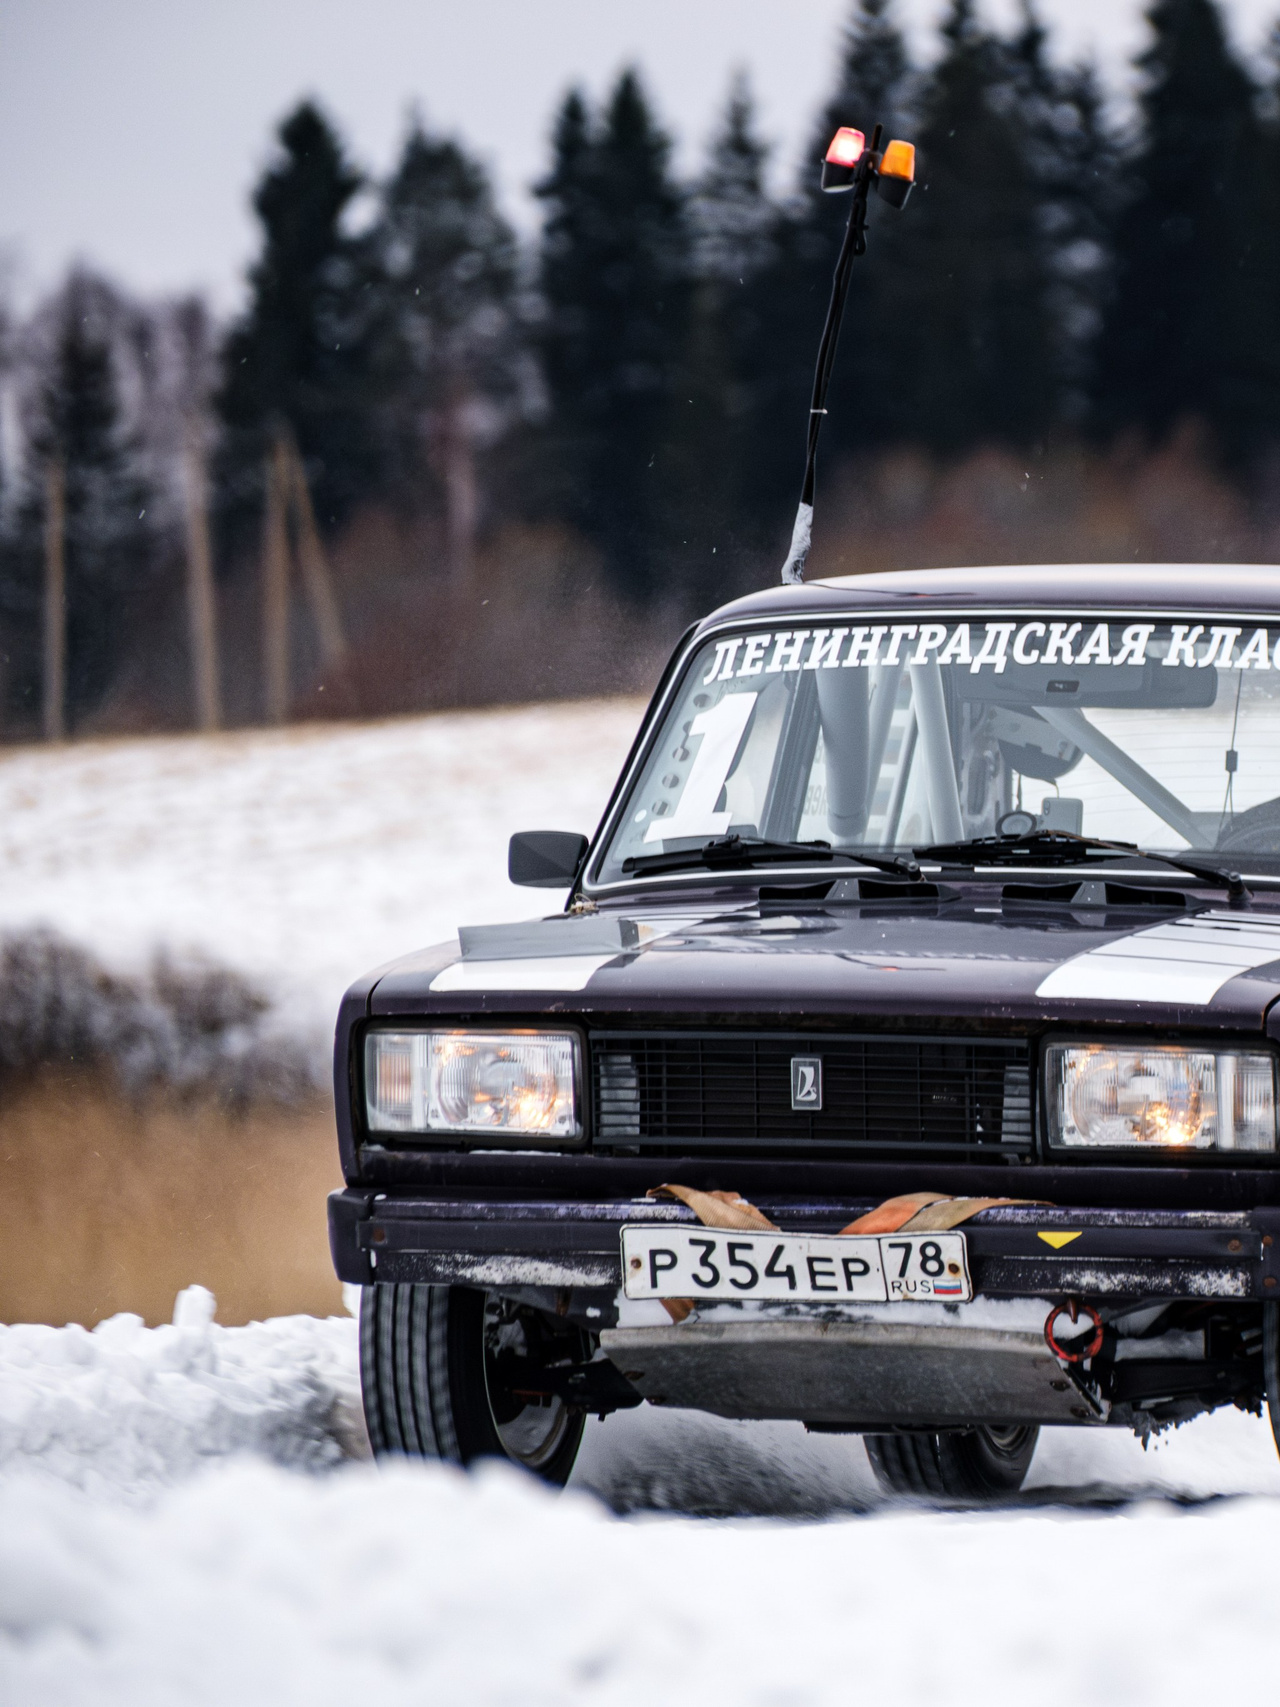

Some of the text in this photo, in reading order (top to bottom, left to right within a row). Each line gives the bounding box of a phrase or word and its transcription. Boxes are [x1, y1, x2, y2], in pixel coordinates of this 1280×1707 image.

[703, 622, 1157, 686] ЛЕНИНГРАДСКАЯ
[643, 691, 758, 844] 1
[888, 1241, 945, 1278] 78
[891, 1280, 931, 1294] RUS
